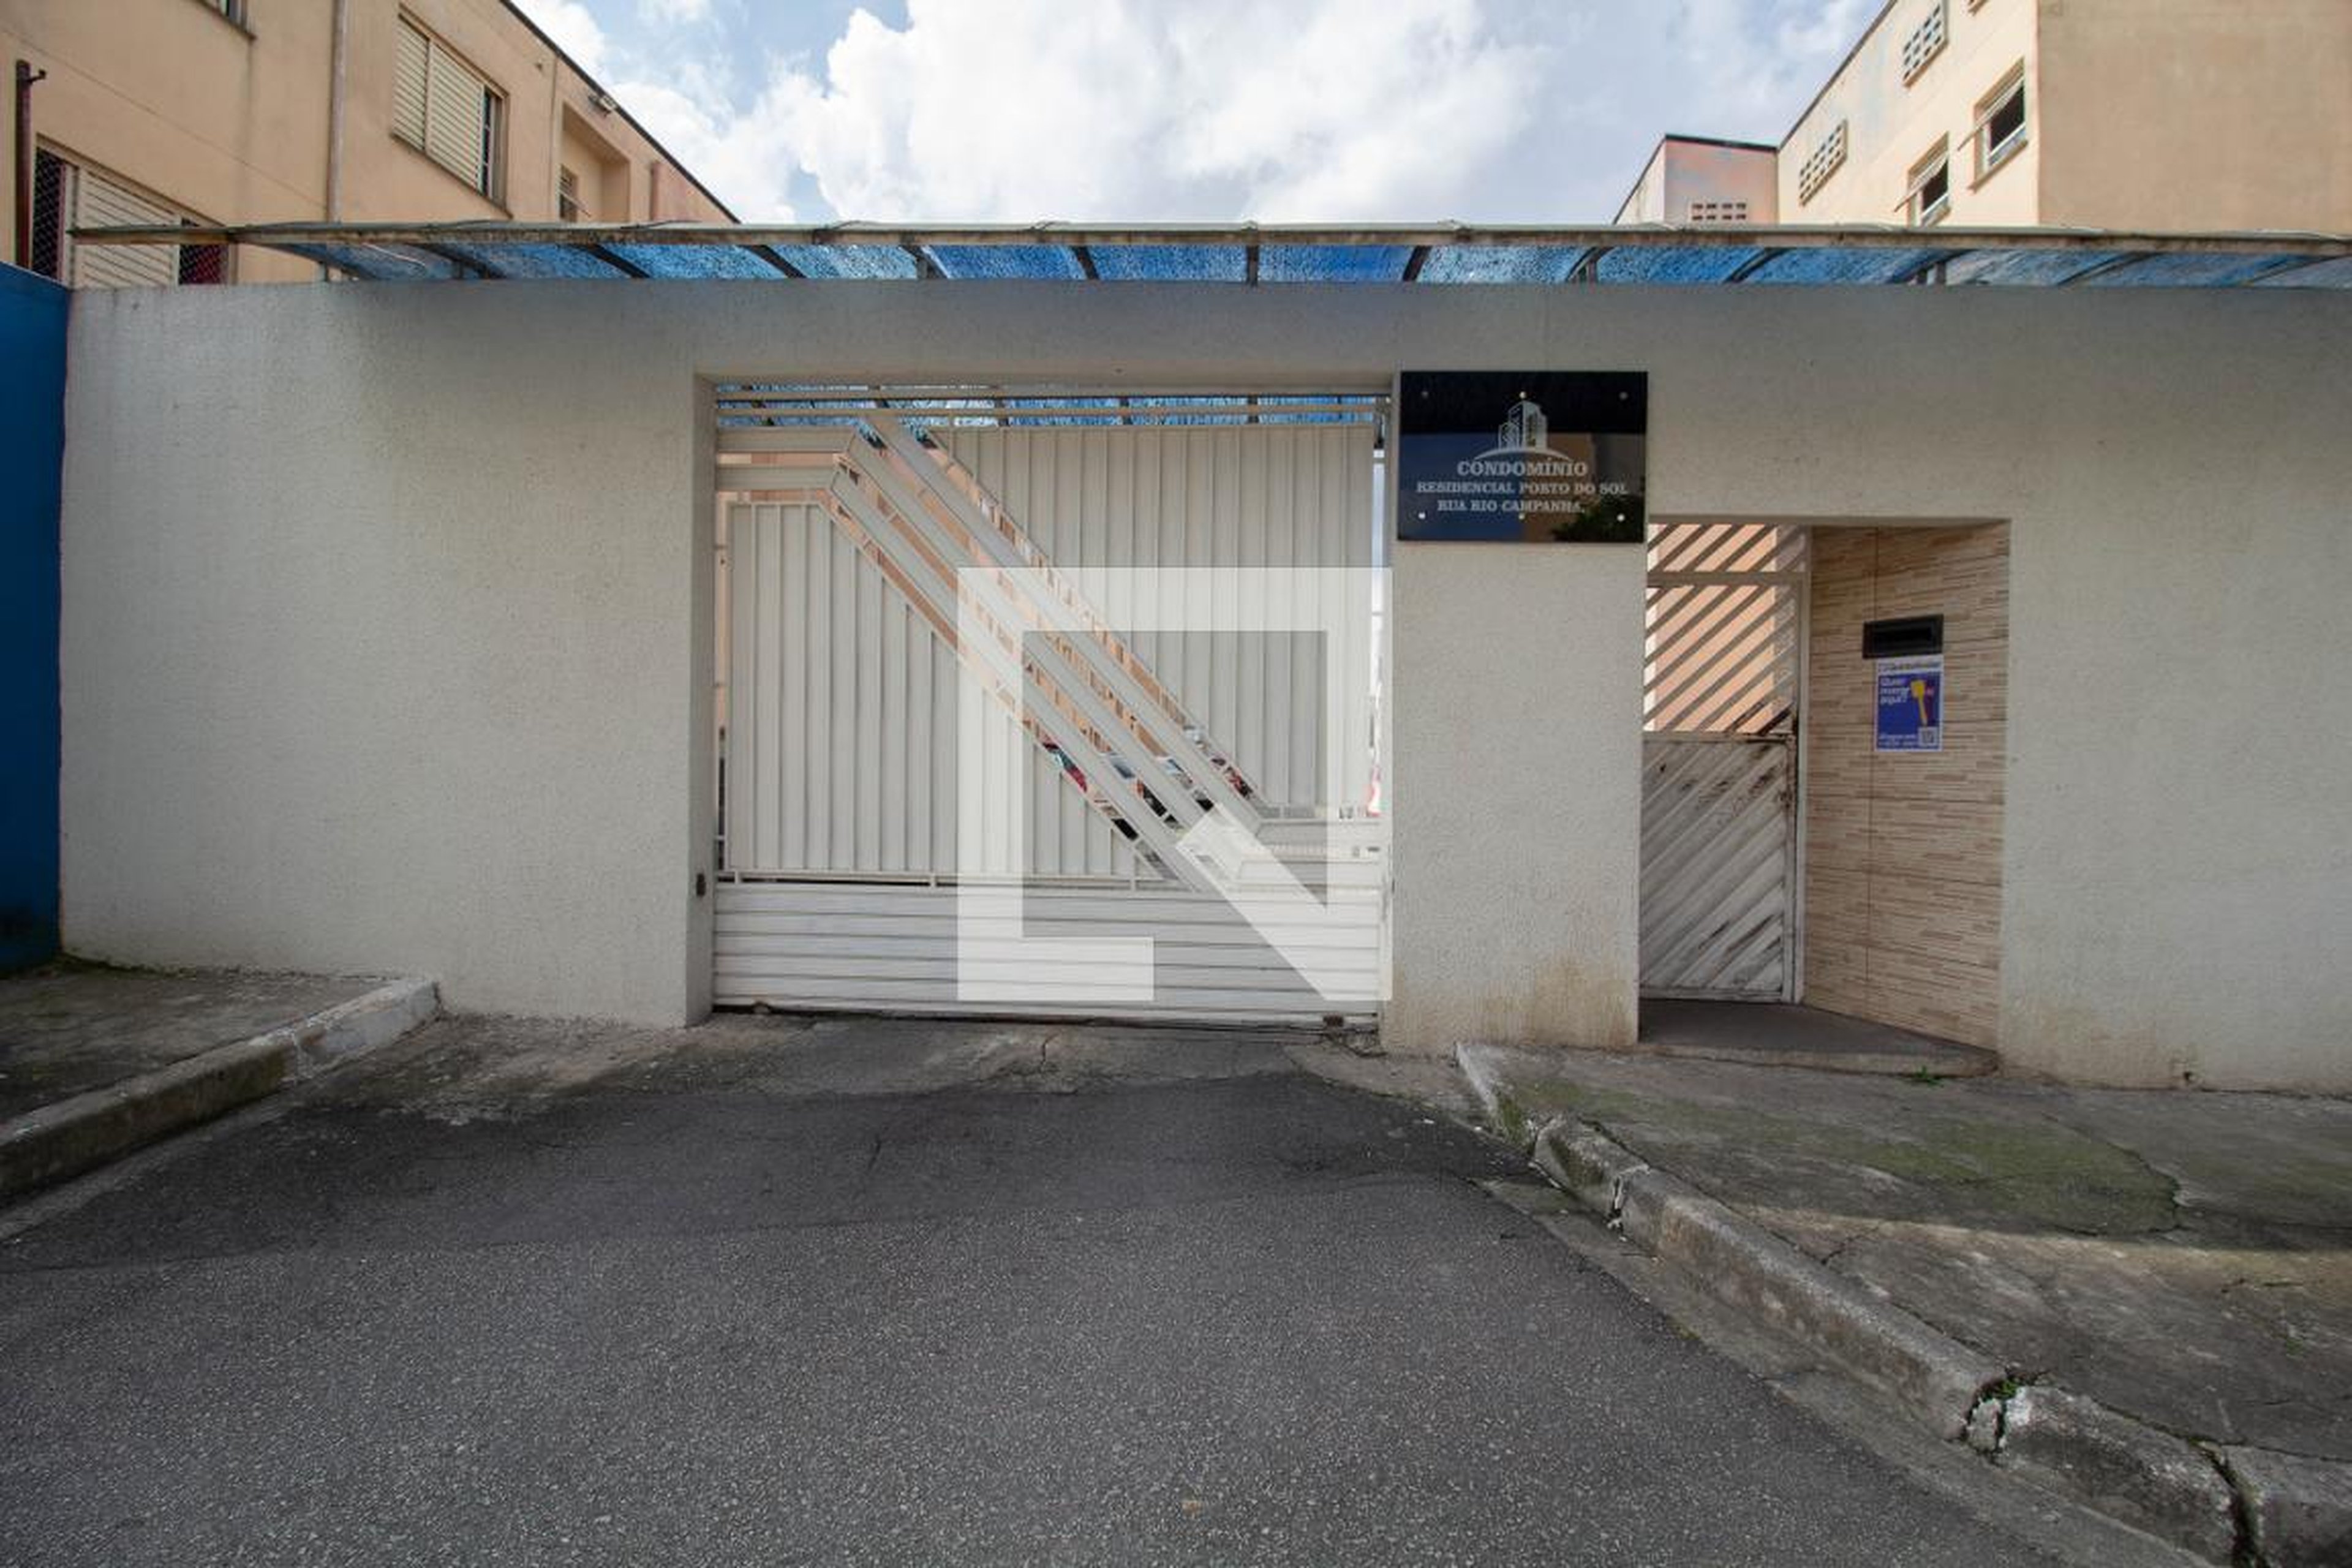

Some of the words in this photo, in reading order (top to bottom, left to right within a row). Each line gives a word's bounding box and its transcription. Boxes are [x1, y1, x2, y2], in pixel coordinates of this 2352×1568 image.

[1457, 457, 1588, 477] CONDOMÍNIO
[1416, 481, 1515, 494] RESIDENCIAL
[1518, 481, 1570, 495] PORTO
[1573, 482, 1596, 496] DO
[1599, 482, 1629, 496] SOL
[1437, 499, 1468, 512] RUA
[1470, 499, 1498, 512] RIO
